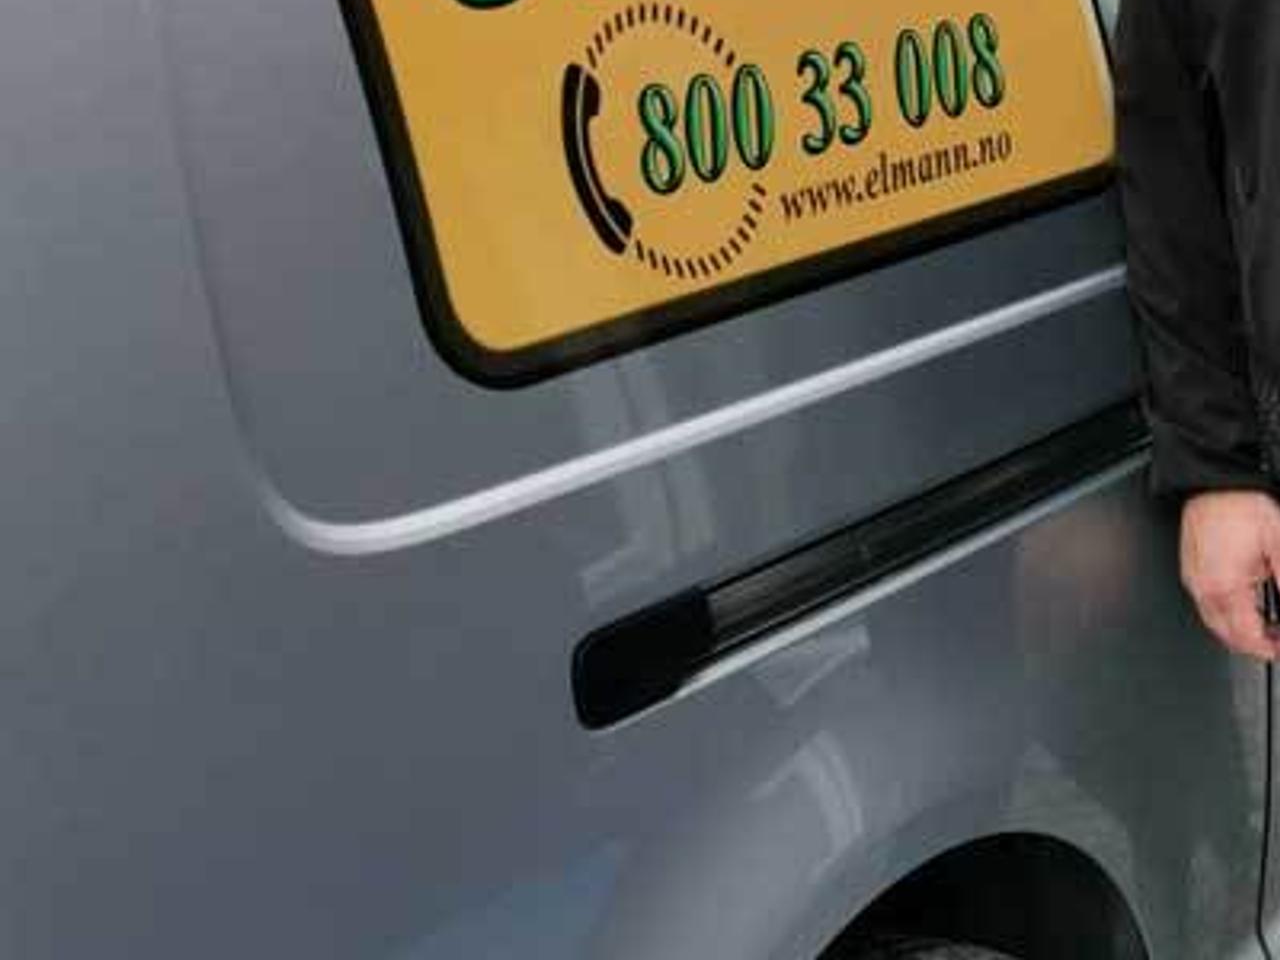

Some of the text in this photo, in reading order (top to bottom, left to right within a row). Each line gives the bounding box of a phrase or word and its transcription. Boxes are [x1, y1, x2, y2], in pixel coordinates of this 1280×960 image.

[637, 12, 1006, 196] 800 33 008
[778, 130, 1013, 224] www.elmann.no
